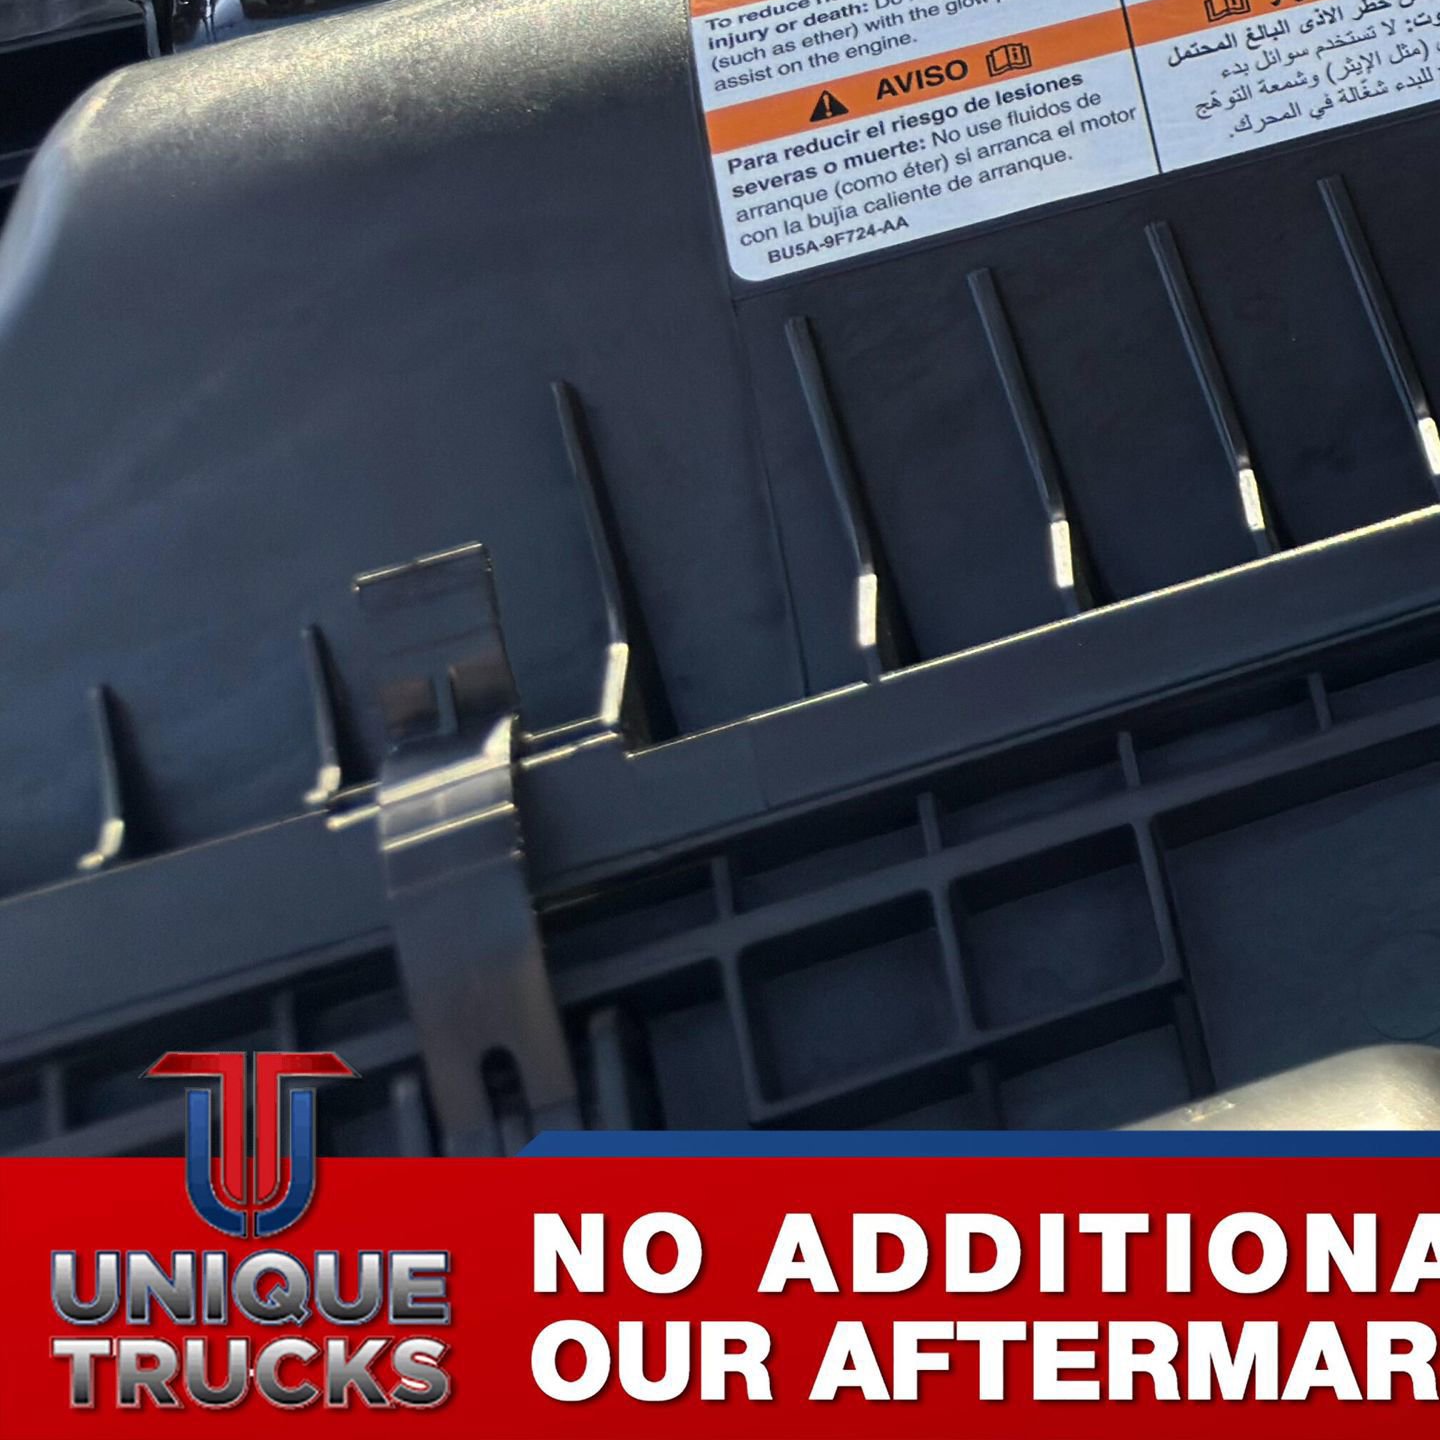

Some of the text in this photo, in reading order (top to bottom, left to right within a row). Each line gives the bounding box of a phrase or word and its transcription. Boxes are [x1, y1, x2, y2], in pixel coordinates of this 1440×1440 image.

[704, 16, 732, 31] To
[707, 26, 769, 50] injury
[774, 19, 798, 34] or
[802, 2, 869, 27] death:
[710, 46, 766, 73] (such
[771, 39, 797, 56] as
[800, 21, 859, 48] ether)
[863, 11, 904, 32] with
[907, 4, 940, 22] the
[713, 32, 917, 92] assist on the engine.
[875, 58, 969, 100] AVISO
[726, 73, 1083, 175] Para reducir el riesgo de lesiones
[731, 91, 1101, 198] severas o muerte: No use fluidos de
[735, 106, 1136, 223] arranque (como éter) si arranca el motor
[738, 225, 778, 247] con
[782, 219, 803, 236] la
[862, 182, 942, 214] caliente
[946, 174, 973, 192] de
[977, 149, 1073, 184] arranque.
[766, 215, 910, 264] BU5A-9F724-AA
